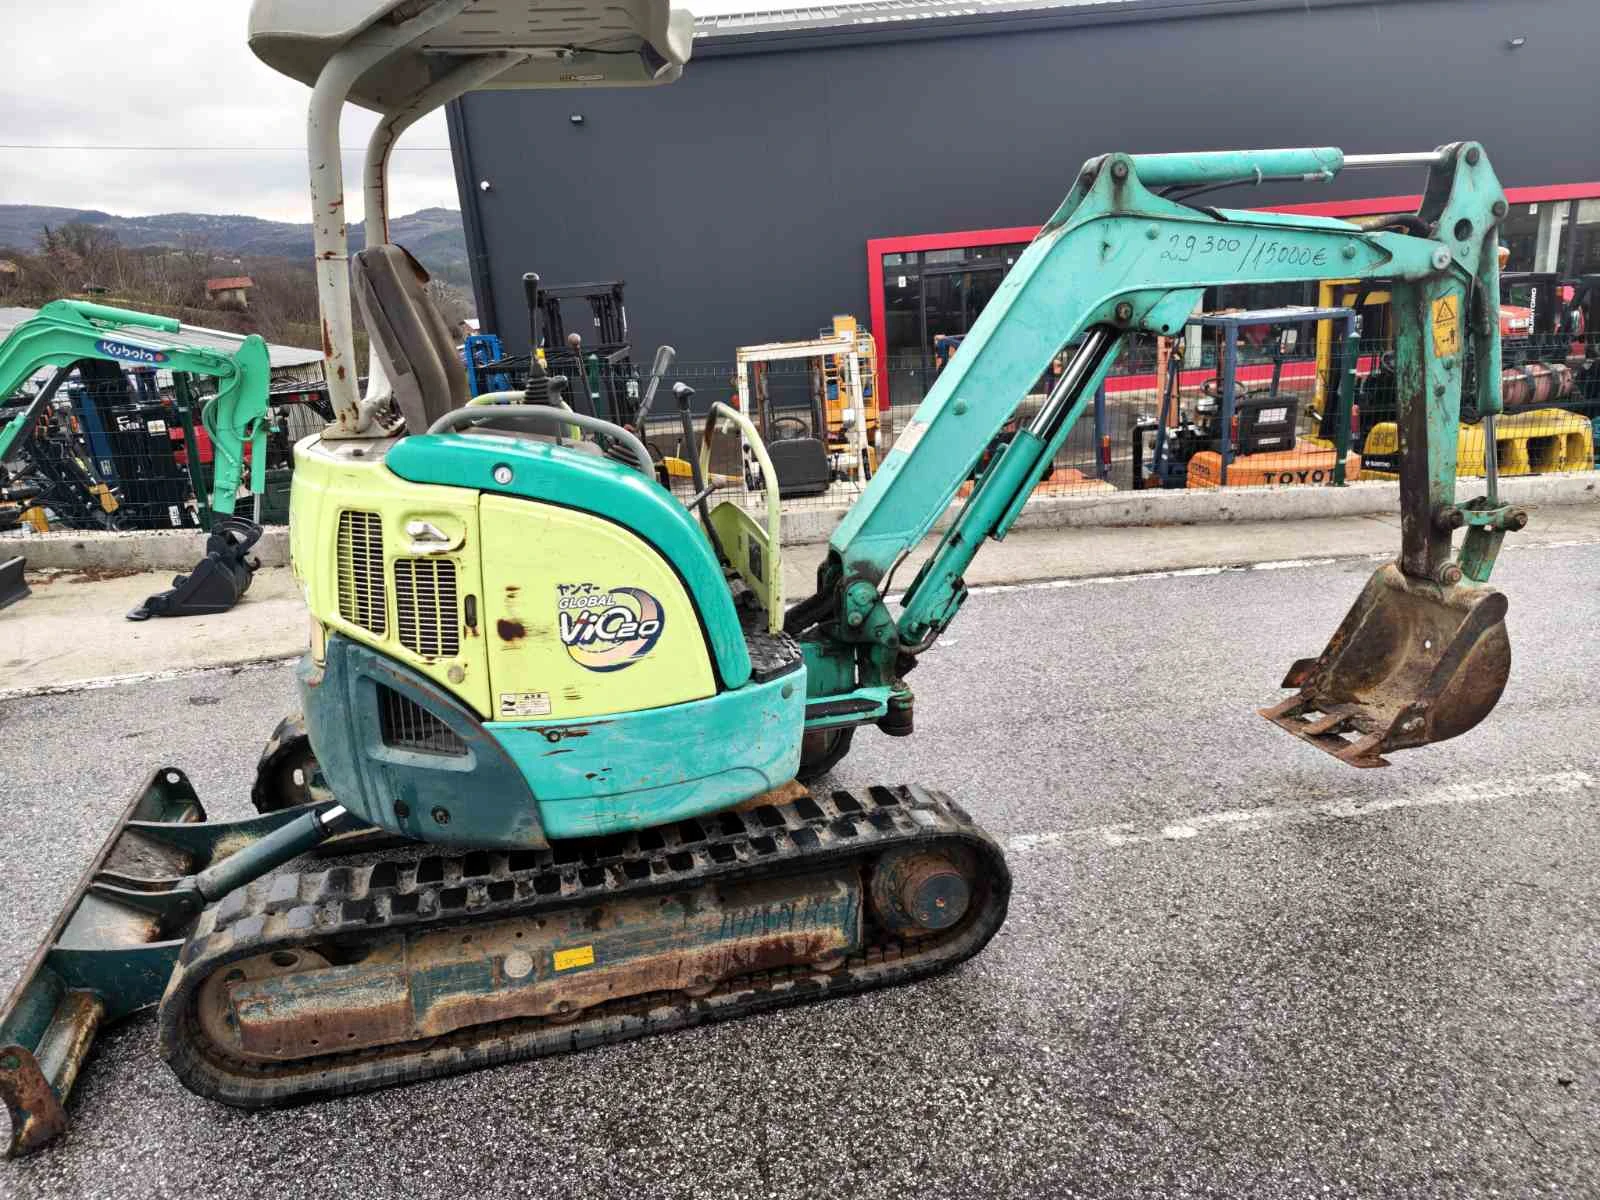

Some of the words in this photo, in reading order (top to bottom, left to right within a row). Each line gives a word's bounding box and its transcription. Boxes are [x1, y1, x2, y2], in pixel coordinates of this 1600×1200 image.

[103, 341, 154, 361] Kubota
[557, 583, 600, 596] ヤンマー
[560, 594, 616, 609] GLOBAL
